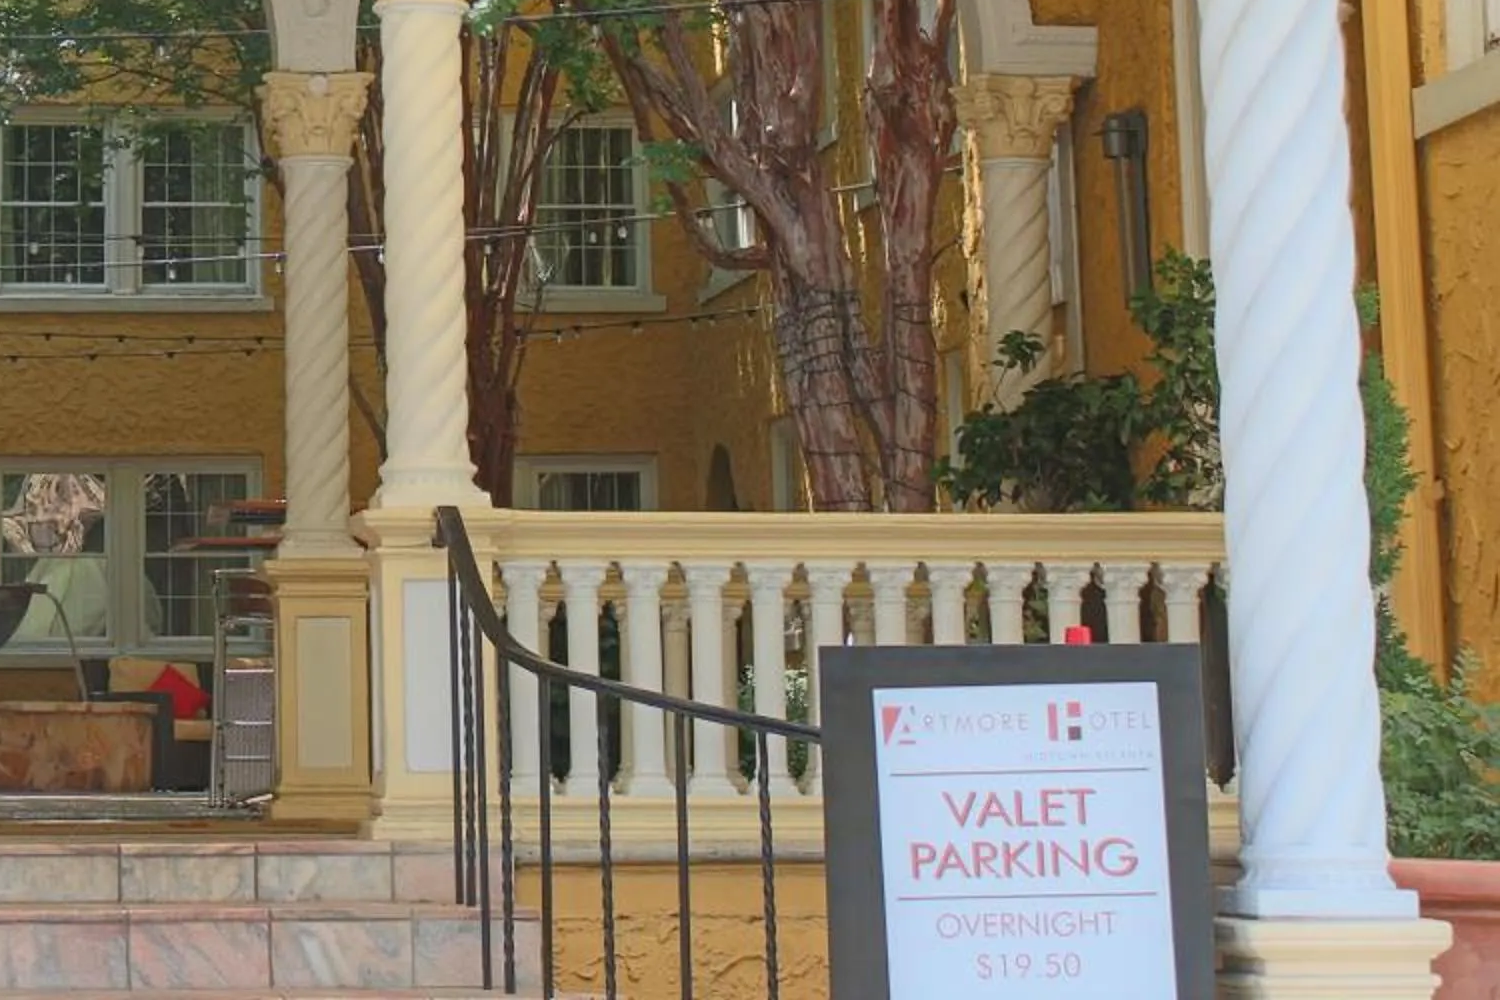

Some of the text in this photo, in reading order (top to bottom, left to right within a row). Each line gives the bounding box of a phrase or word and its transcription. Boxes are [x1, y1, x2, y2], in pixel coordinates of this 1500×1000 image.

[1047, 701, 1153, 742] HOTEL
[941, 788, 1097, 828] VALET
[909, 837, 1139, 881] PARKING
[935, 910, 1117, 939] OVERNIGHT
[975, 953, 1082, 981] $19.50
